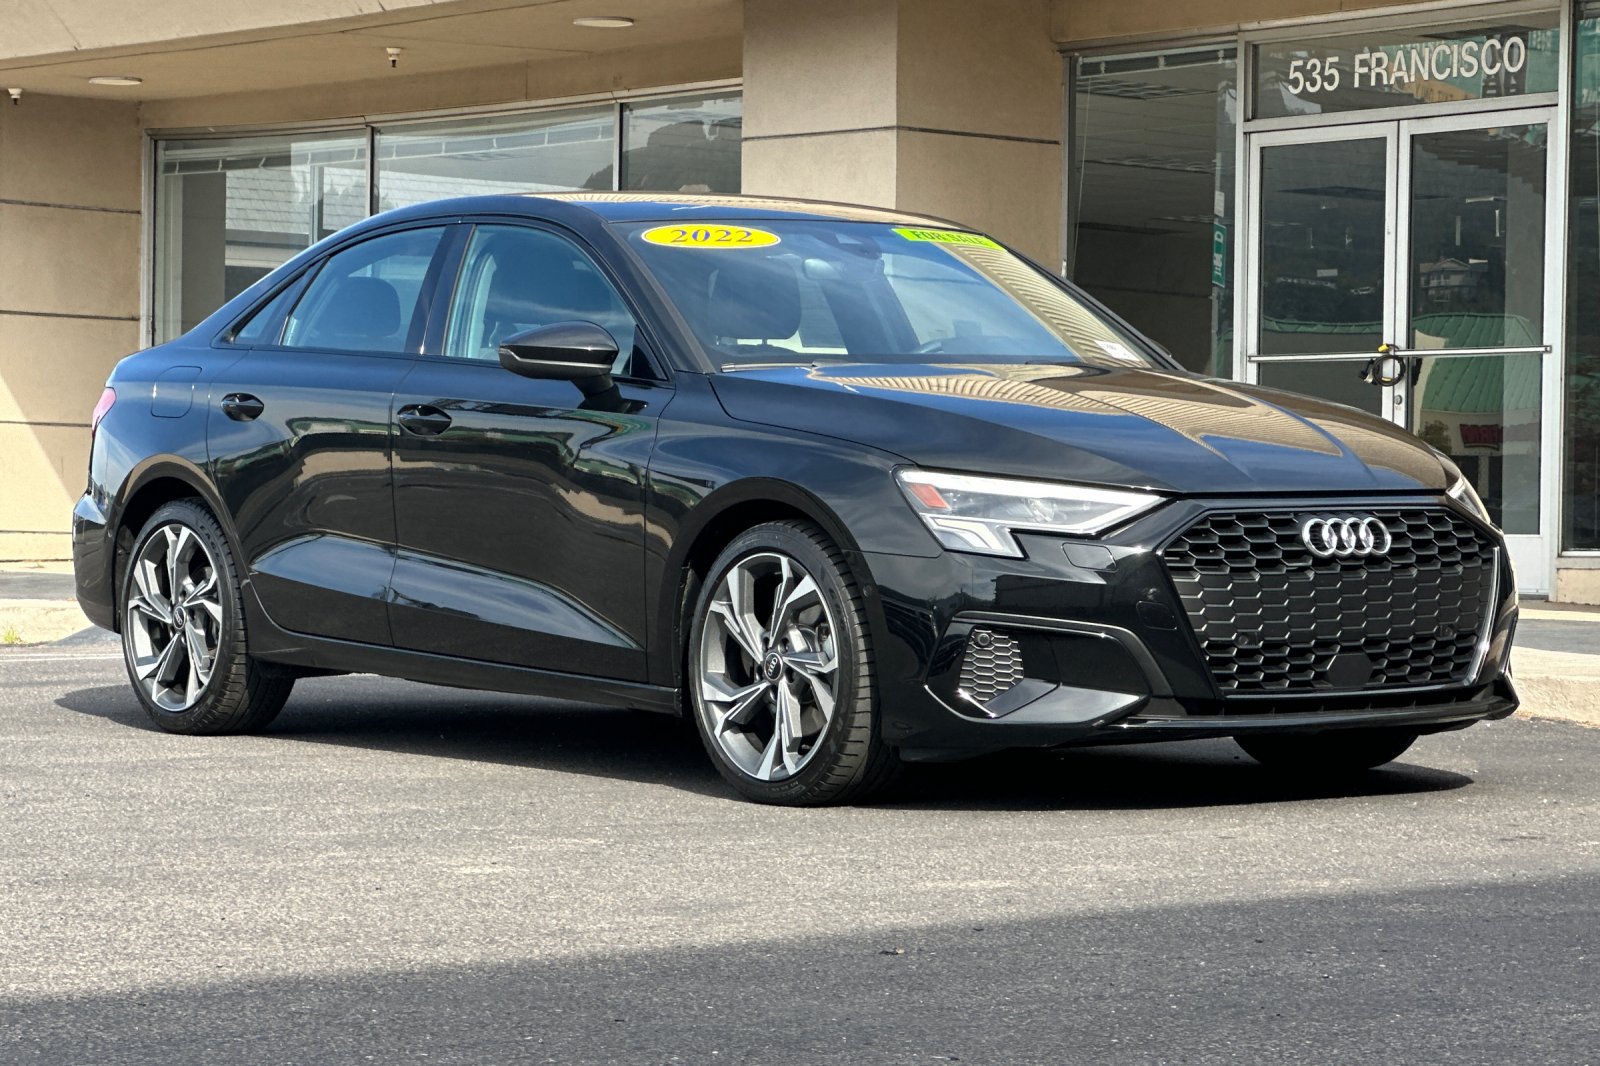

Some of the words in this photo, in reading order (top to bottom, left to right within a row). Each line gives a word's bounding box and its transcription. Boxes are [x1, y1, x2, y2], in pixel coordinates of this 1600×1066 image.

[1288, 56, 1340, 95] 535
[1353, 36, 1526, 88] FRANCISCO
[670, 229, 753, 243] 2022
[908, 230, 943, 241] FOR
[945, 233, 985, 245] SALE
